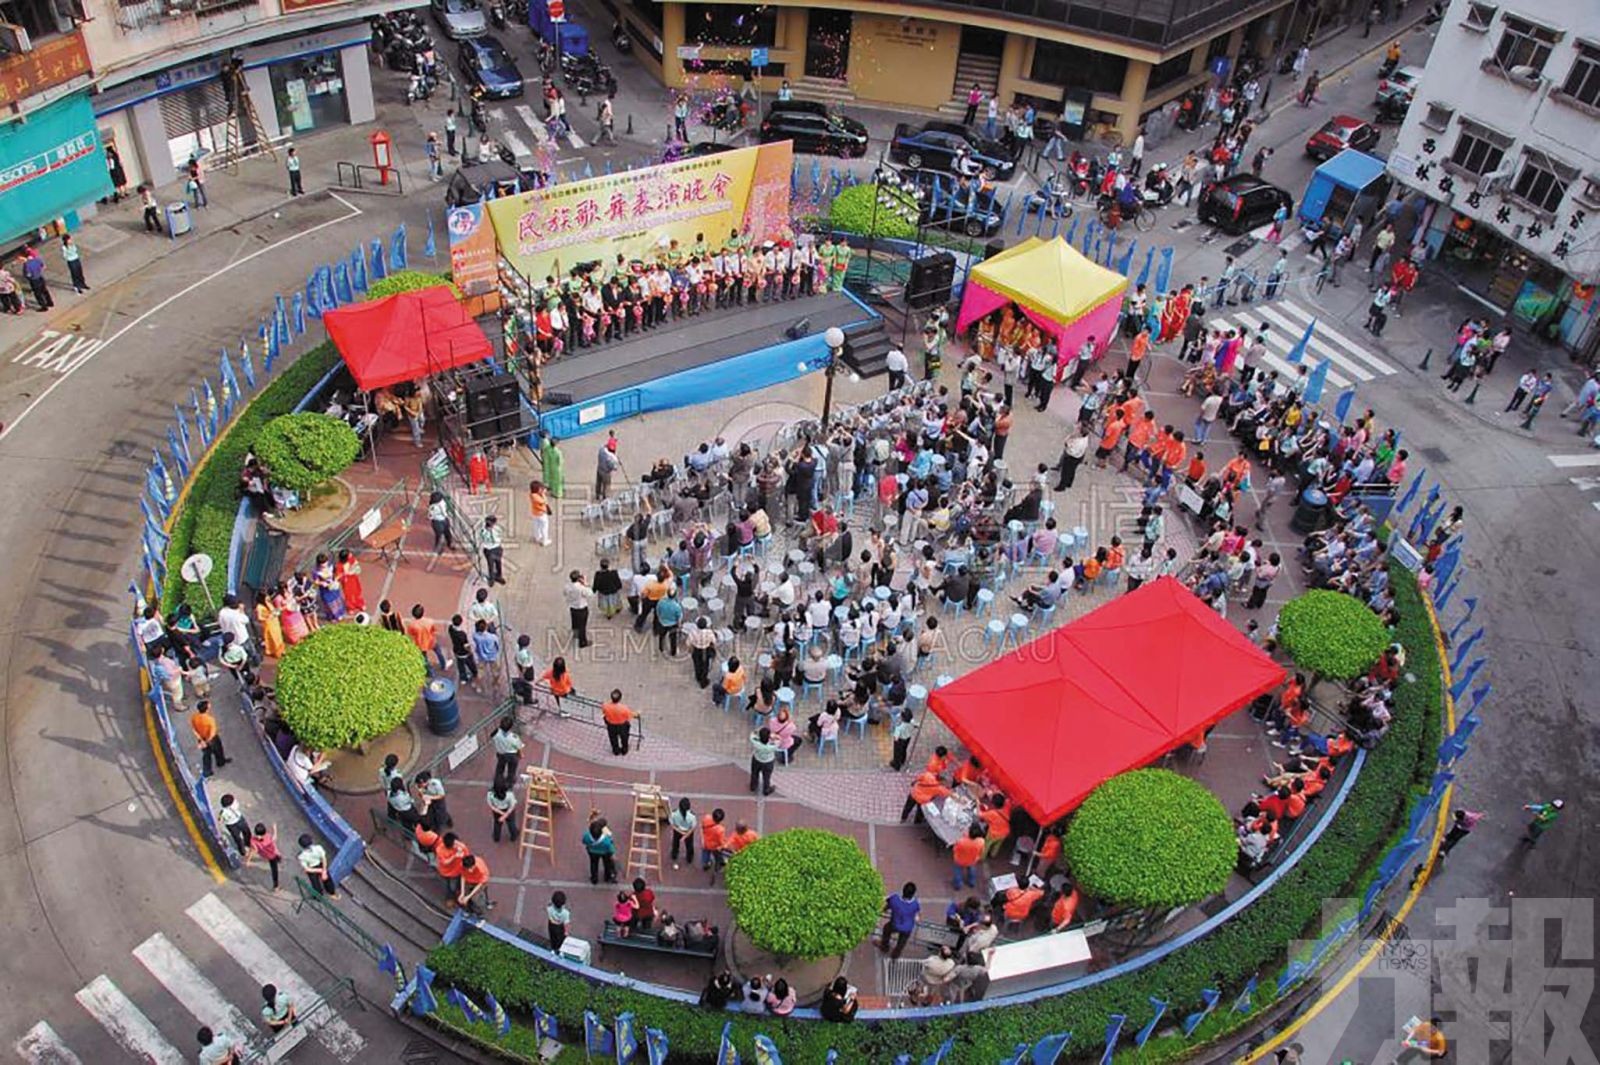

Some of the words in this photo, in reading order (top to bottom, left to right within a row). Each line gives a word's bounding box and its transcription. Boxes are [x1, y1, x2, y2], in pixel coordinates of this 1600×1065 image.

[519, 173, 733, 242] 民族歌舞表演晚會
[11, 331, 102, 374] TAXI
